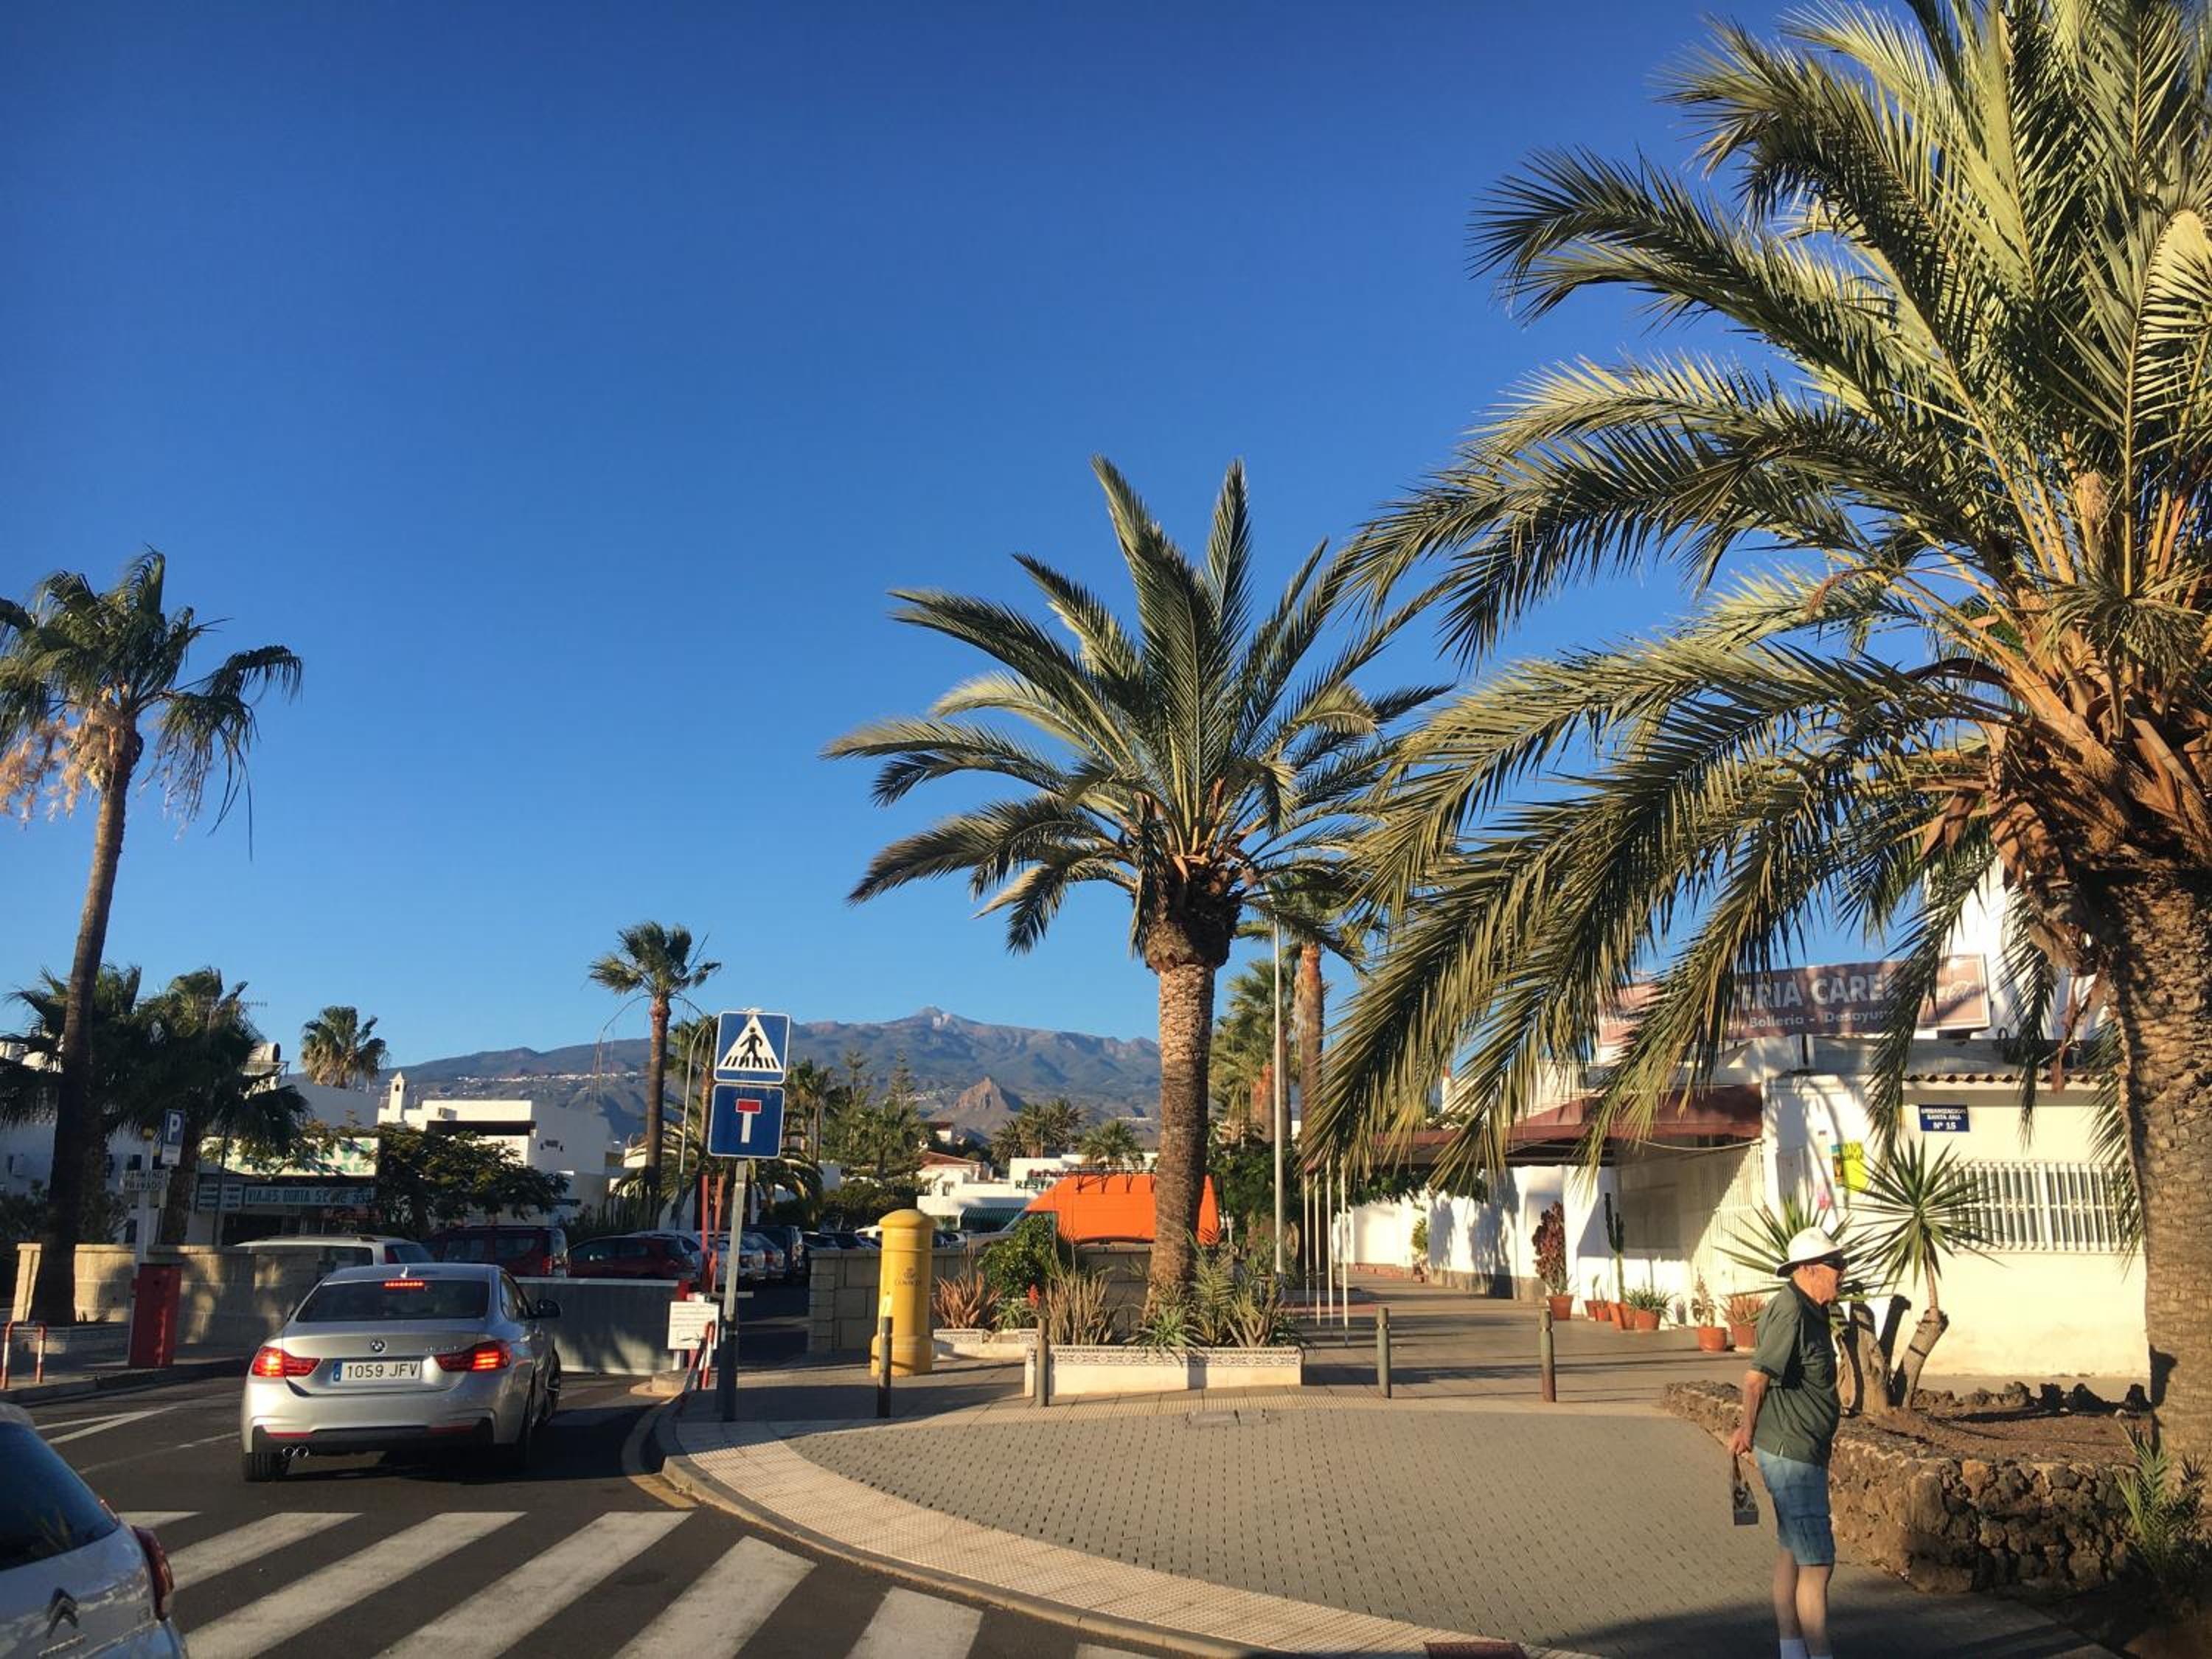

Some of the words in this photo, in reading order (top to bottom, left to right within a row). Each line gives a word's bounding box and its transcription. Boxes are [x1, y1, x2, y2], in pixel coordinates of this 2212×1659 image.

[168, 1113, 181, 1142] P
[347, 1365, 384, 1378] 1059
[389, 1363, 419, 1377] JFV
